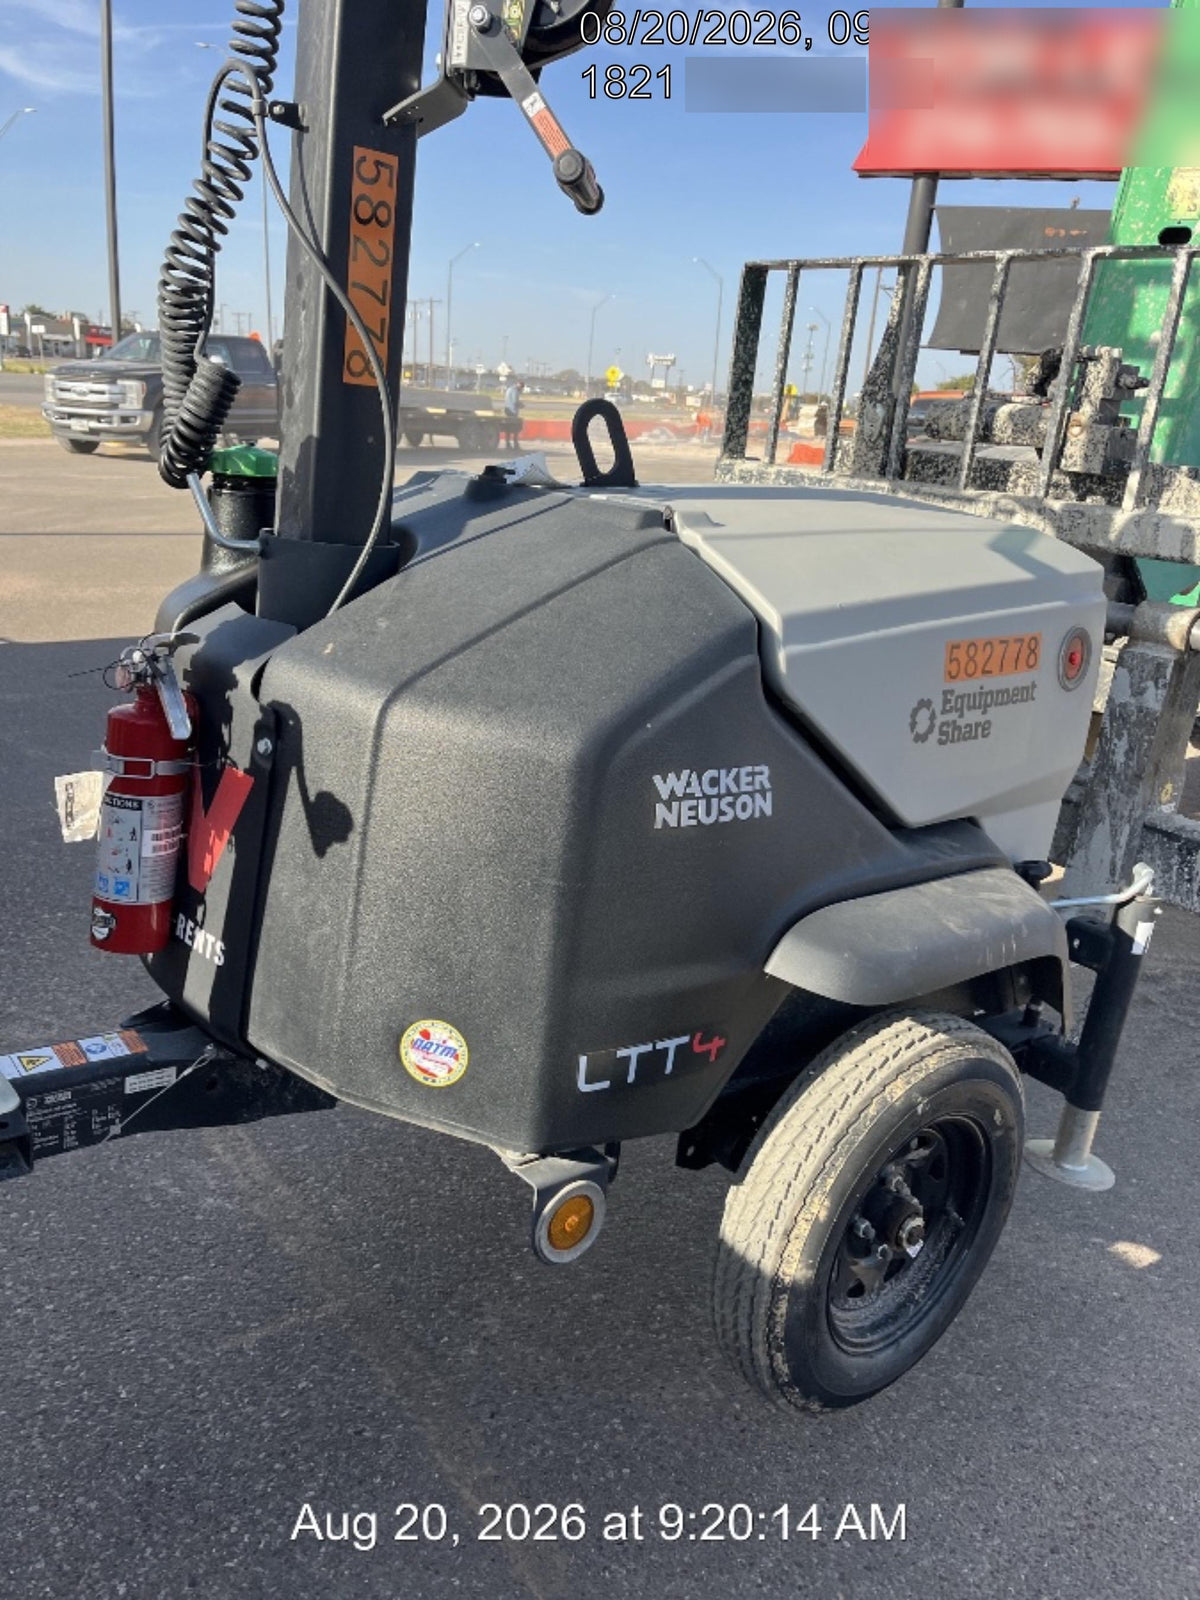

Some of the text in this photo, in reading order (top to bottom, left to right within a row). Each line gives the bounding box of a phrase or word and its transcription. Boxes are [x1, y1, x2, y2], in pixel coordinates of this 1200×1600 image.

[346, 155, 394, 379] 582778
[947, 636, 1039, 680] 582778
[940, 680, 1037, 719] Equipment
[937, 719, 992, 746] Share
[652, 765, 771, 800] WACKER
[654, 791, 772, 829] NEUSON
[175, 912, 226, 966] RENTS
